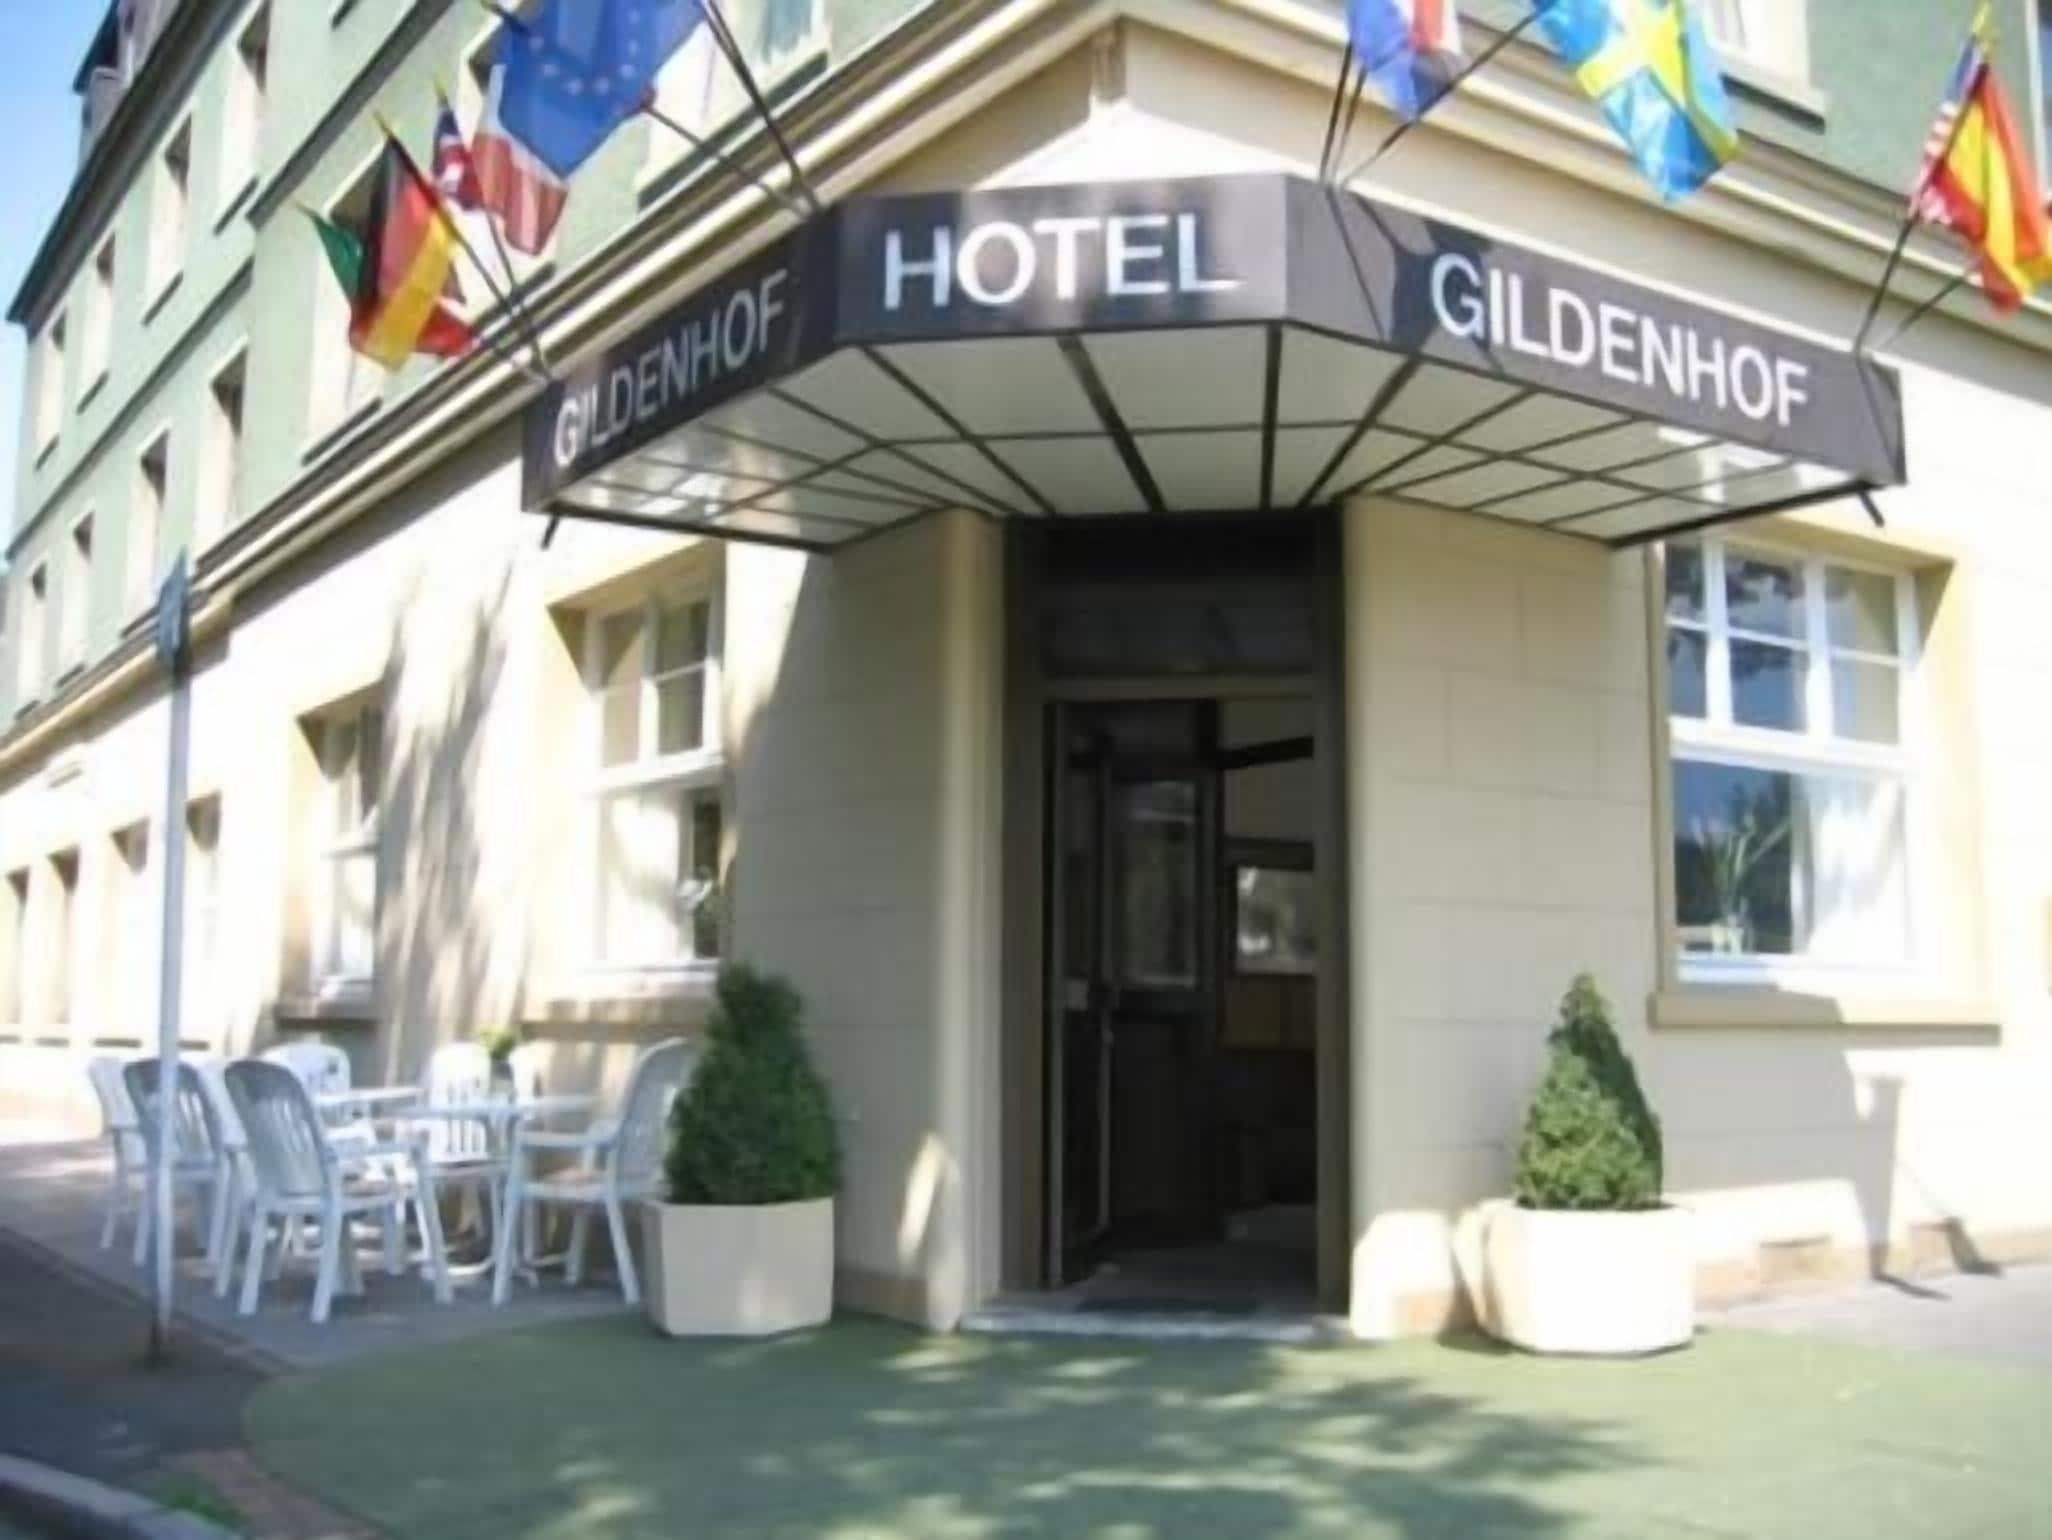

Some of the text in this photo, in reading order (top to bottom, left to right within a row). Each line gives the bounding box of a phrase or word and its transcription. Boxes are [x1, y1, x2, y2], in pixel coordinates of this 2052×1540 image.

[883, 212, 1243, 310] HOTEL
[1430, 252, 1809, 426] GILDENHOF
[553, 268, 788, 468] GILDENHOF
